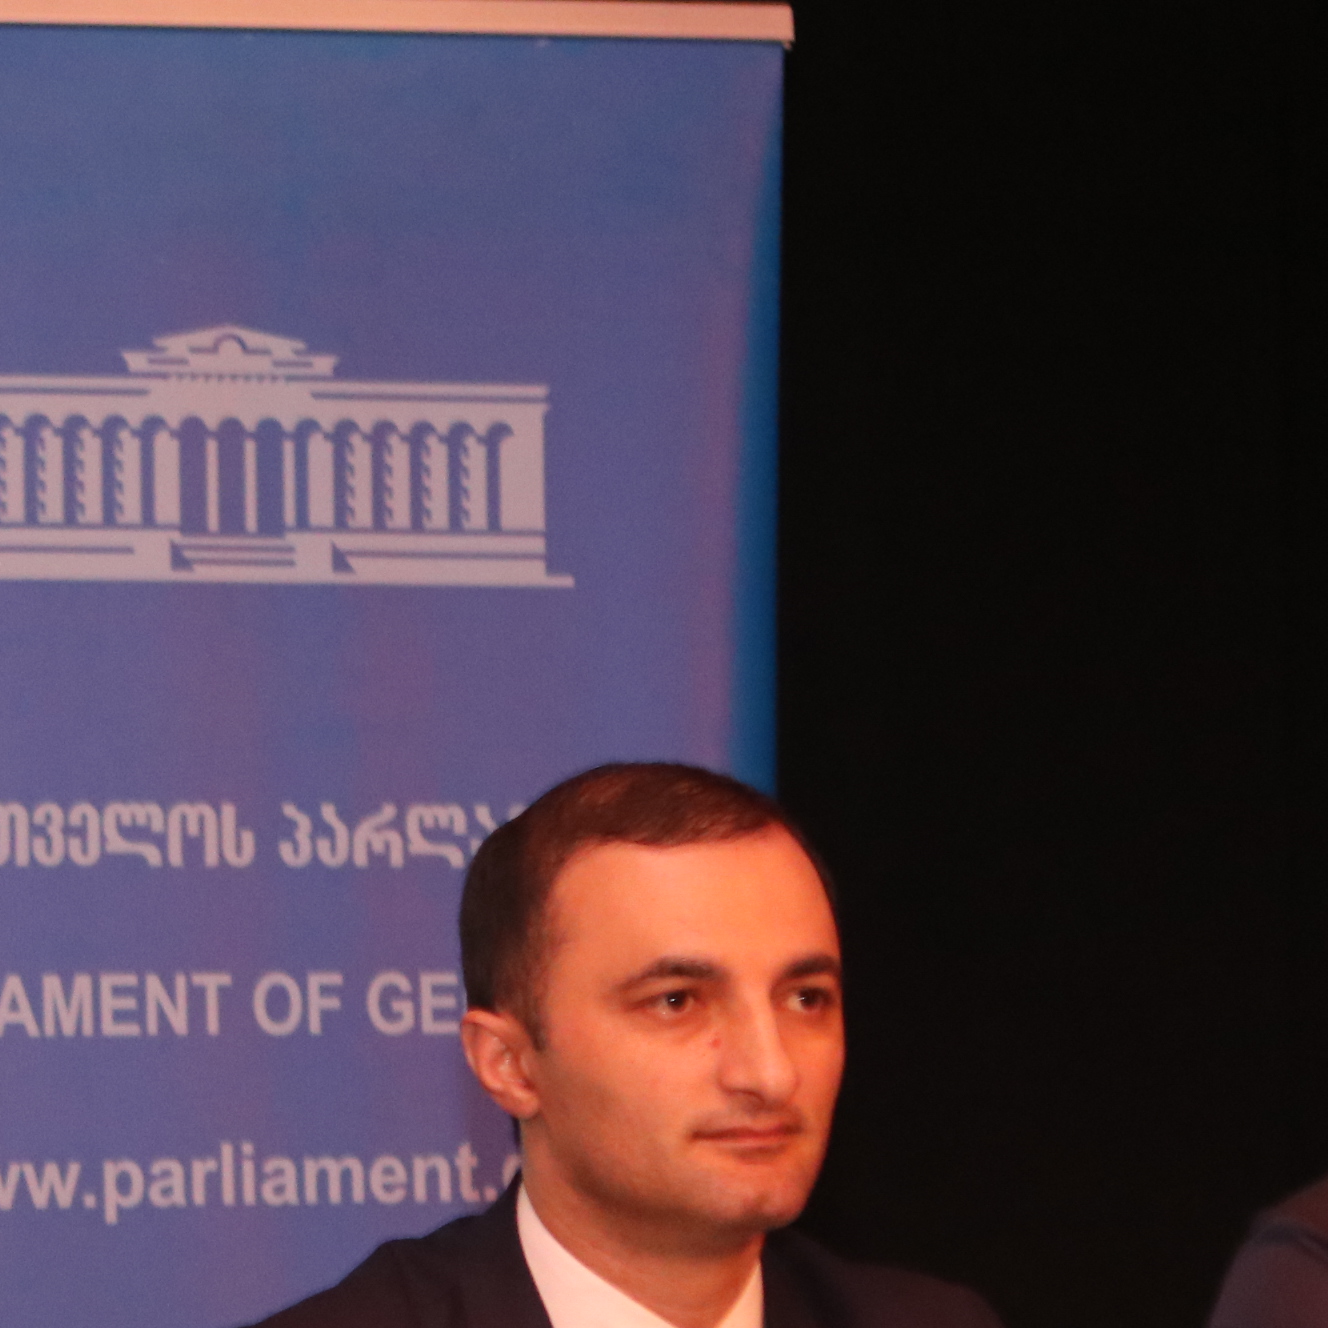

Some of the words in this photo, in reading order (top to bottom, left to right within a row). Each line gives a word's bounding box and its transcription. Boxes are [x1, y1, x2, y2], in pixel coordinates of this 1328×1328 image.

[278, 802, 524, 869] პარლ
[251, 971, 344, 1037] OF
[365, 970, 466, 1036] GE
